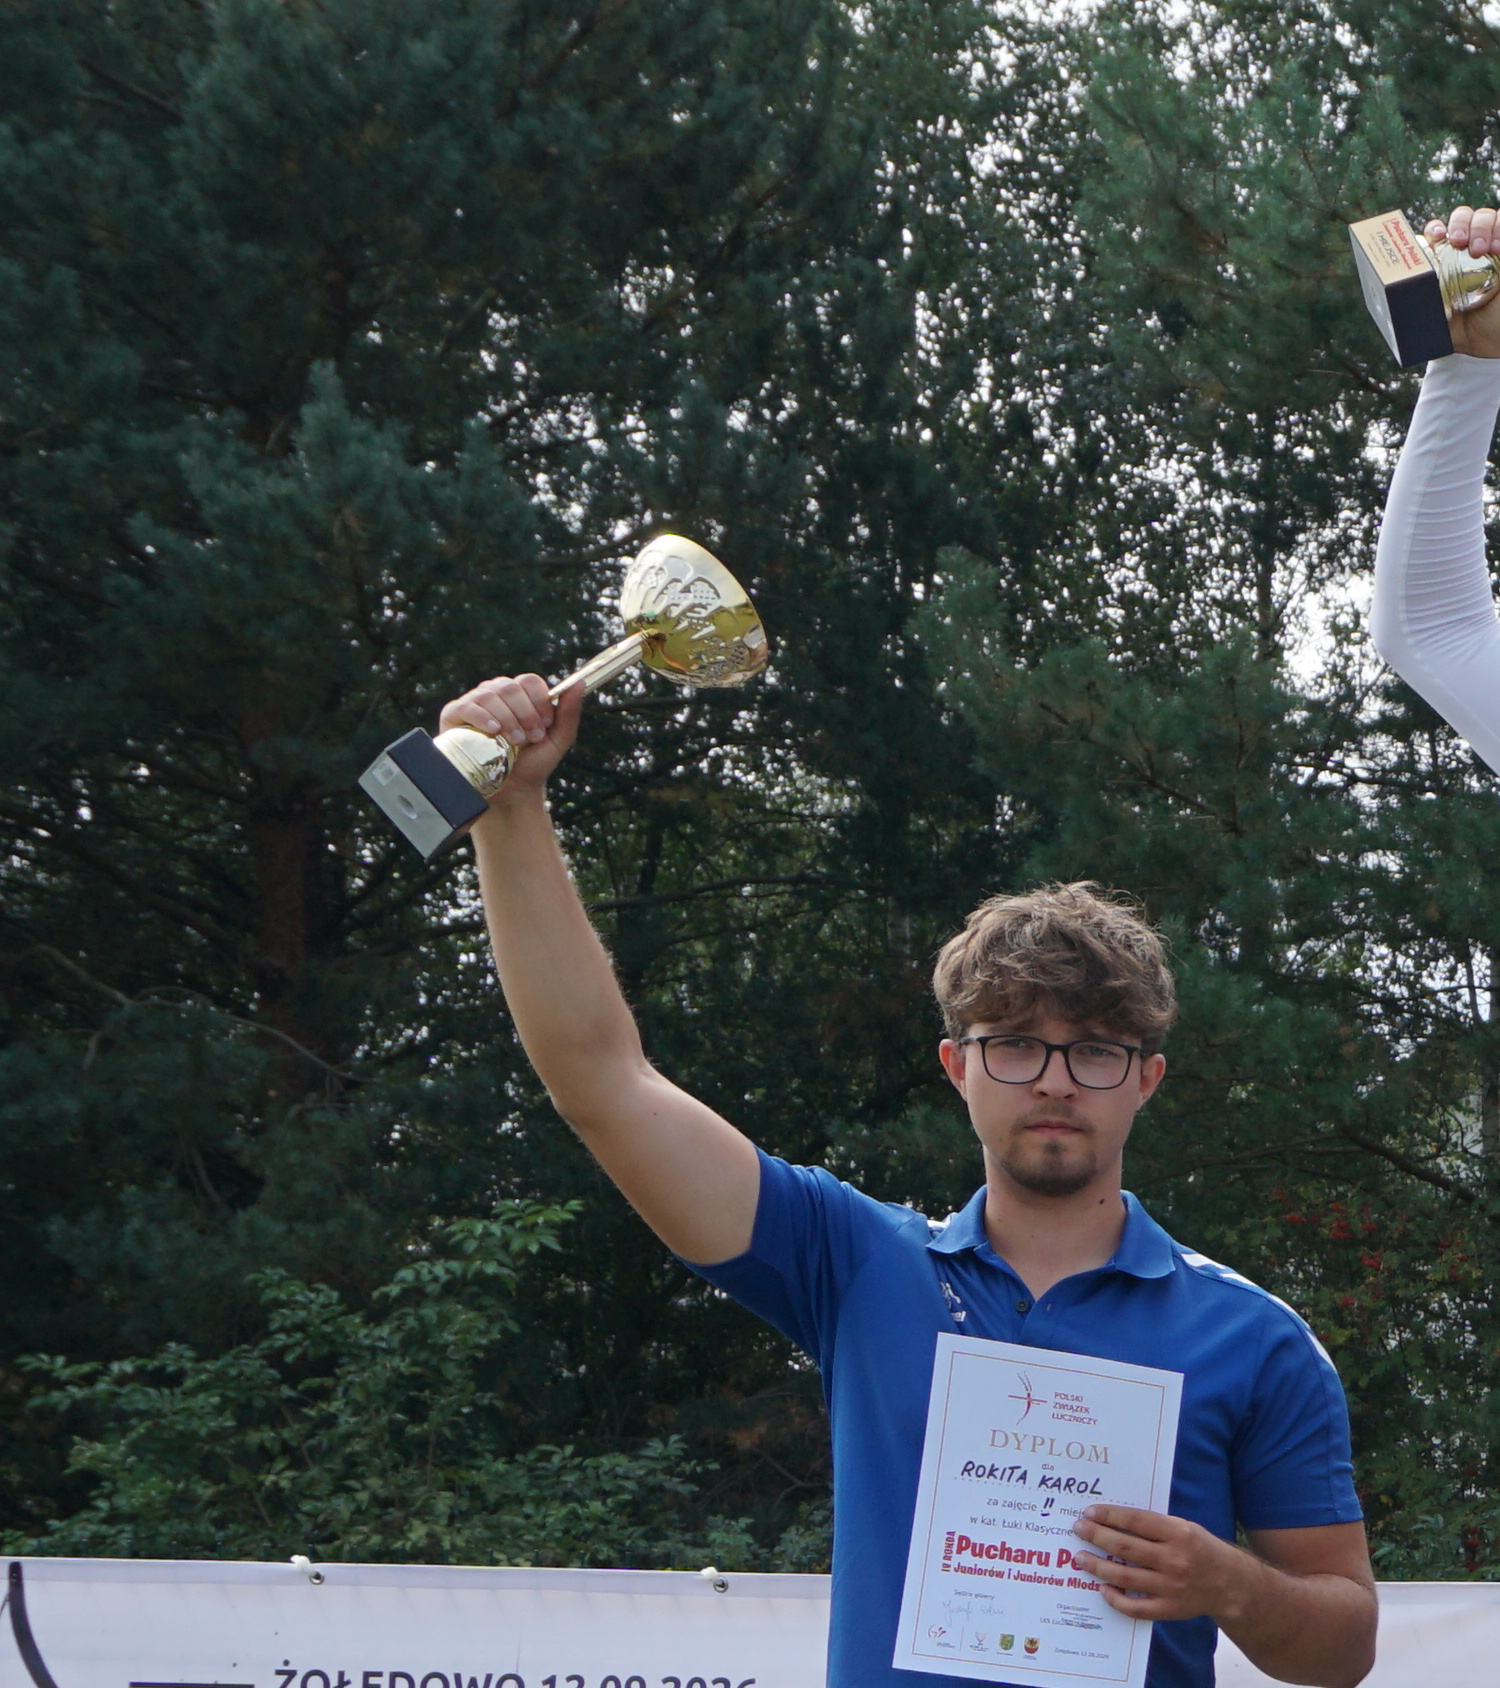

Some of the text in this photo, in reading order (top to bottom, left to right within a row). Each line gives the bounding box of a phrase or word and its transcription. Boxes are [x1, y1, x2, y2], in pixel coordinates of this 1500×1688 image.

[1054, 1391, 1084, 1403] POLSKI
[989, 1429, 1111, 1465] DYPLOM
[960, 1460, 1104, 1495] ROKITA KAROL
[955, 1534, 1051, 1568] Pucharu
[953, 1562, 1065, 1588] Juniorów i Juniorów
